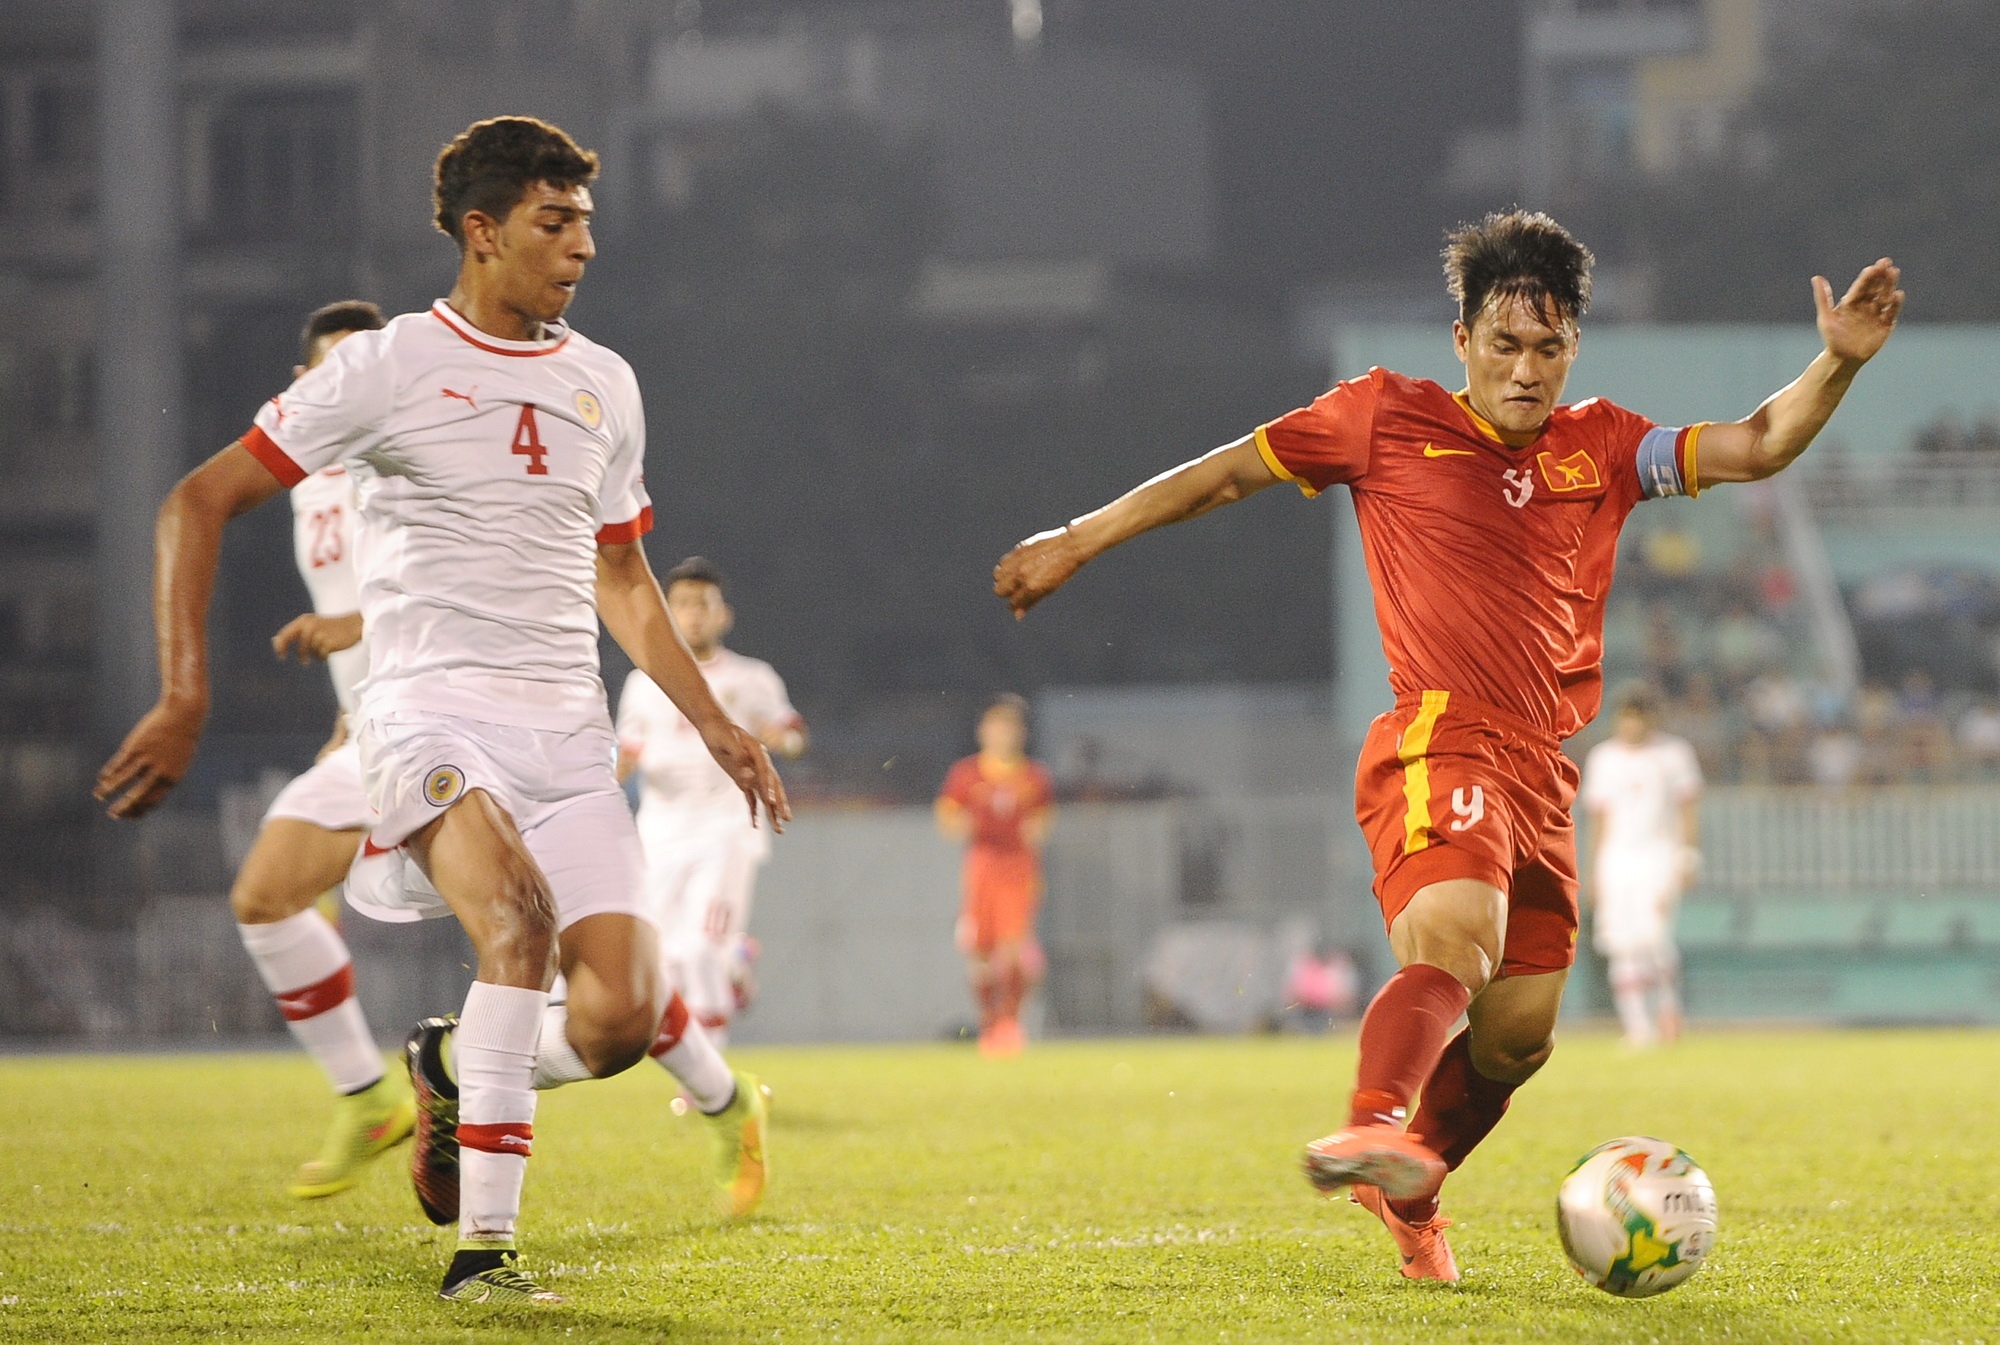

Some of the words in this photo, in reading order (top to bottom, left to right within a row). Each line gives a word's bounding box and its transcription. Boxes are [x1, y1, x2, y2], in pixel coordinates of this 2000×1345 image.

[511, 403, 550, 475] 4
[309, 505, 343, 568] 23
[1450, 785, 1485, 832] 9
